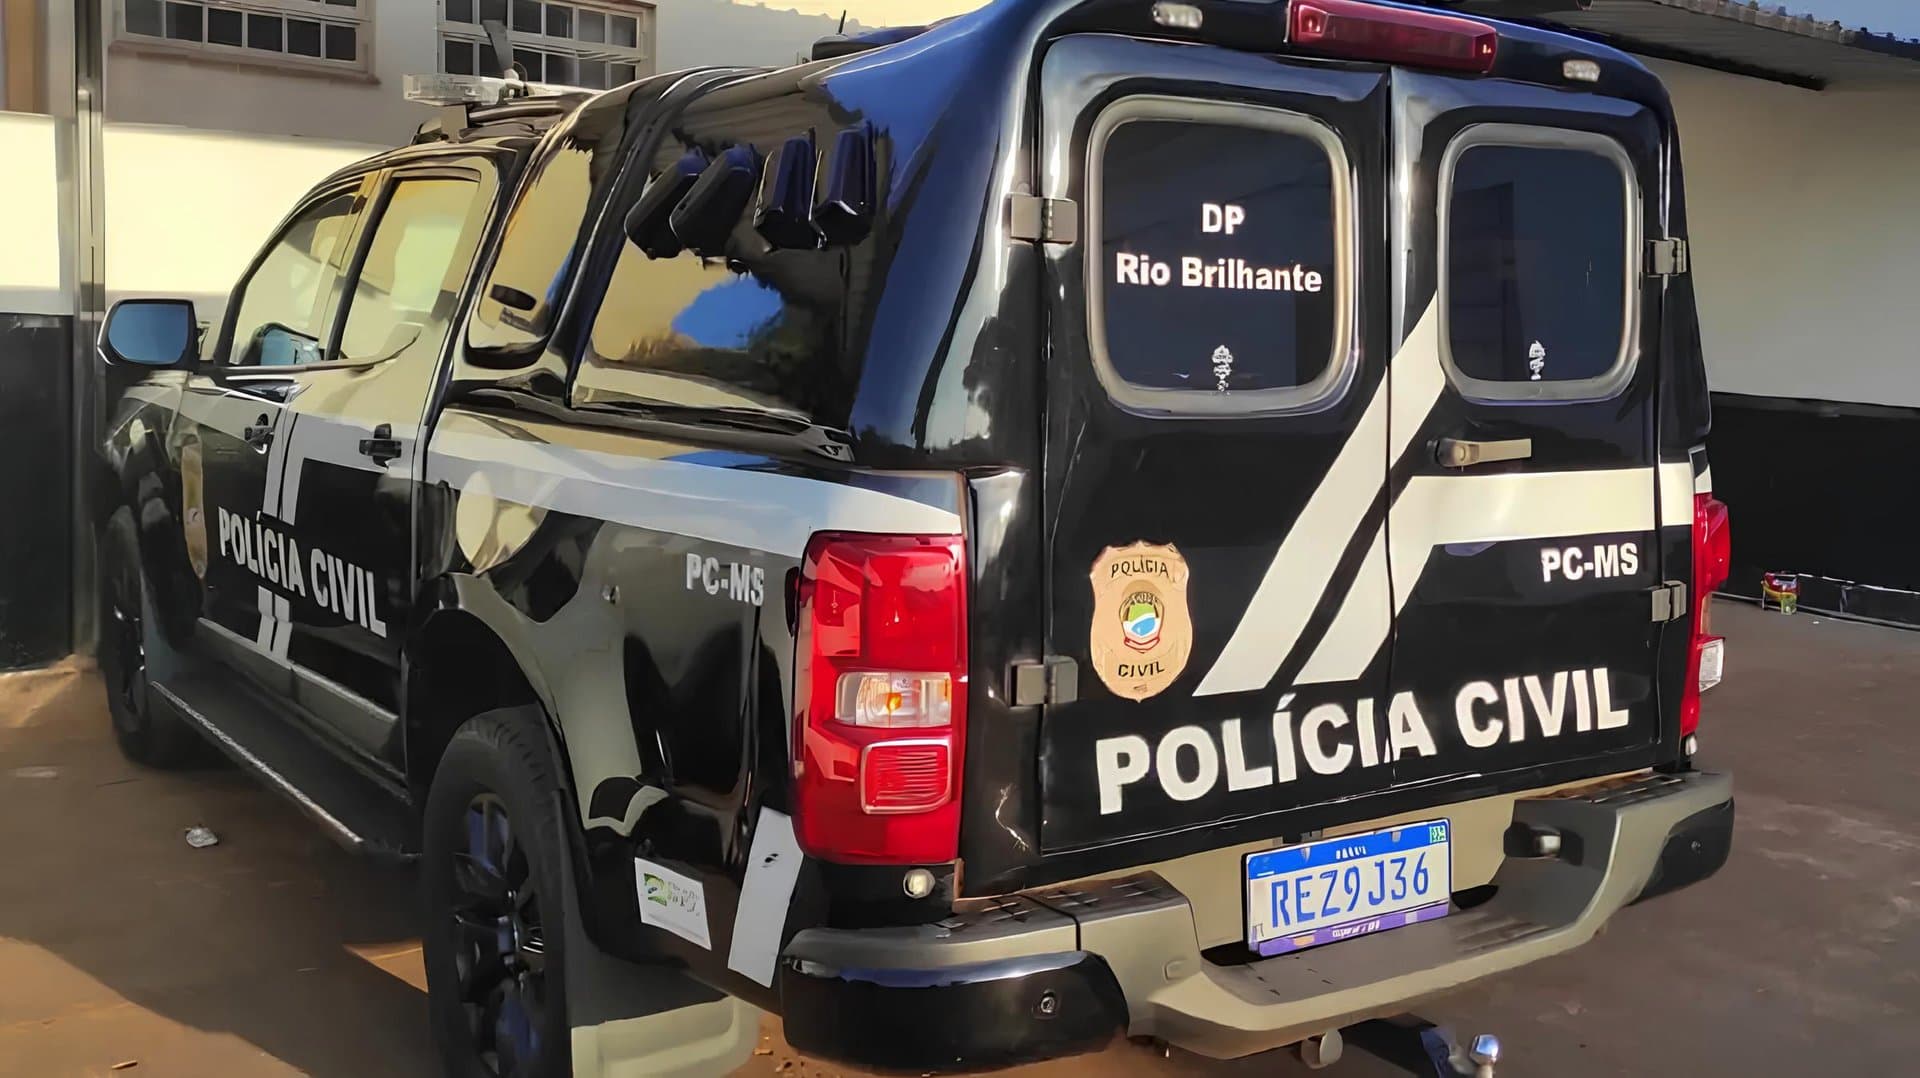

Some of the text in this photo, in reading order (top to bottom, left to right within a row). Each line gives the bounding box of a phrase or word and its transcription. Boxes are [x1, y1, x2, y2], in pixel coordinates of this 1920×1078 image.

[1202, 204, 1244, 234] DP
[1116, 253, 1322, 292] Rio Brilhante
[218, 506, 387, 638] POLÍCIA CIVIL
[686, 553, 765, 606] PC-MS
[1111, 555, 1169, 578] POLÍCIA
[1541, 543, 1639, 582] PC-MS
[1118, 661, 1165, 677] CIVIL
[1096, 667, 1629, 814] POLÍCIA CIVIL
[1271, 851, 1429, 928] REZ9J36
